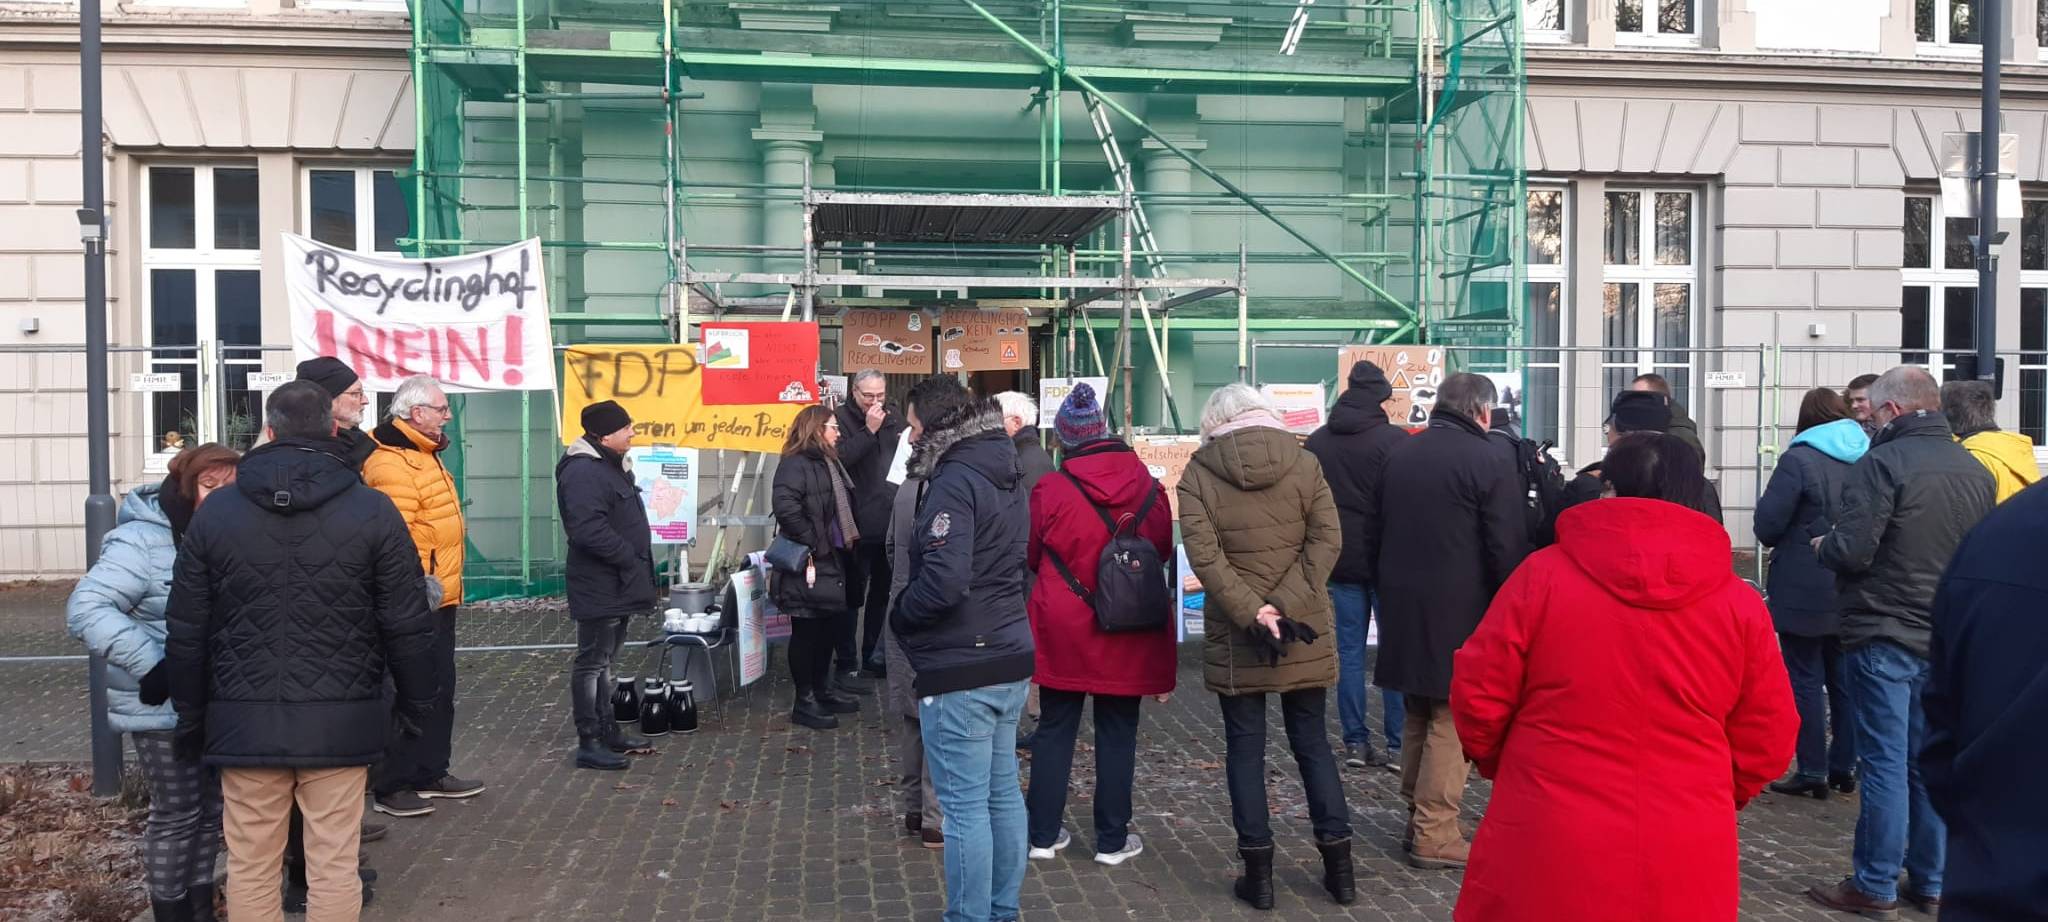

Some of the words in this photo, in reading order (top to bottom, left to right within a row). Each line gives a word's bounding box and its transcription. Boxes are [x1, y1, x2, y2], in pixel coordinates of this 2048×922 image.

[305, 249, 537, 314] Recyclinghof
[848, 312, 897, 328] STOPP
[966, 323, 992, 337] KEIN
[847, 350, 927, 366] RECYCLINGHOF
[568, 348, 701, 399] FDP
[684, 421, 705, 435] um
[709, 414, 752, 442] jeden
